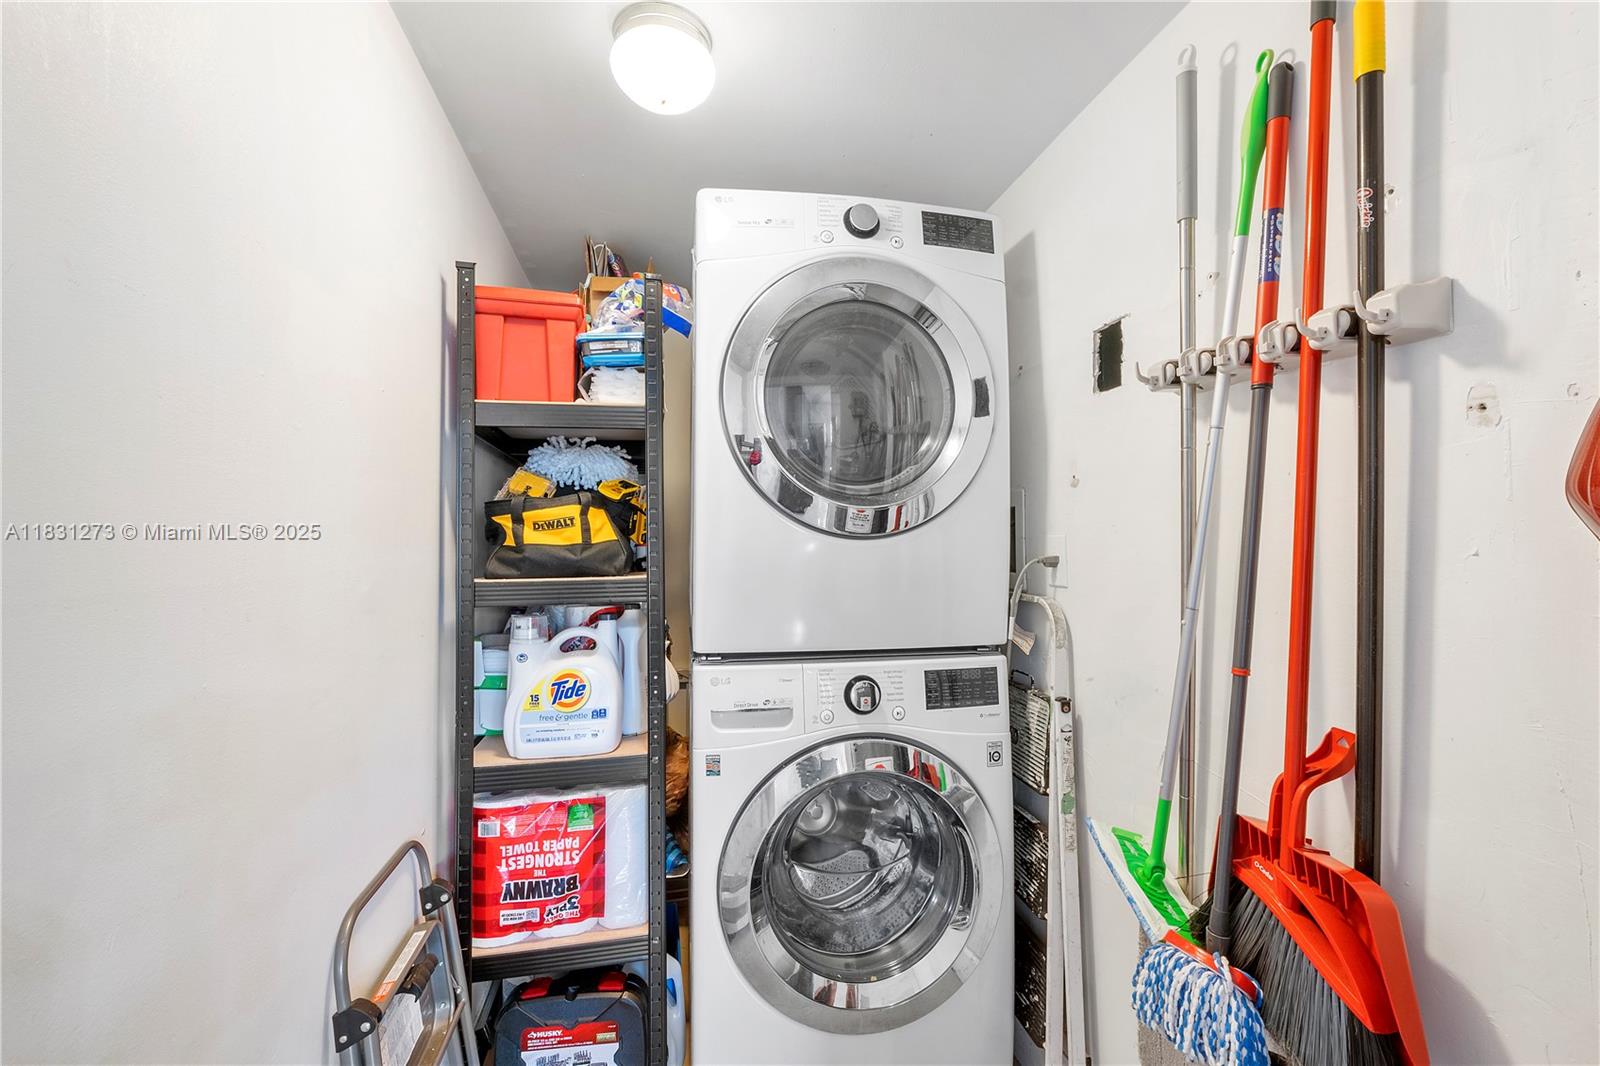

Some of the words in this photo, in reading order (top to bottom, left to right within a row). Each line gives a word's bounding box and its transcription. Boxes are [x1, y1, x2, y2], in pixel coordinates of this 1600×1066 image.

[532, 517, 576, 531] DEWALT
[529, 694, 540, 702] 15
[551, 680, 587, 705] Tide
[554, 714, 563, 722] &
[564, 713, 589, 722] gentle
[500, 841, 540, 856] TOWEL
[543, 837, 579, 852] PAPER
[500, 851, 580, 870] STRONGEST
[533, 869, 546, 877] THE
[502, 875, 579, 902] BRAWNY
[544, 913, 564, 923] ONLY
[564, 910, 579, 918] THE
[537, 1030, 563, 1038] HUSKY
